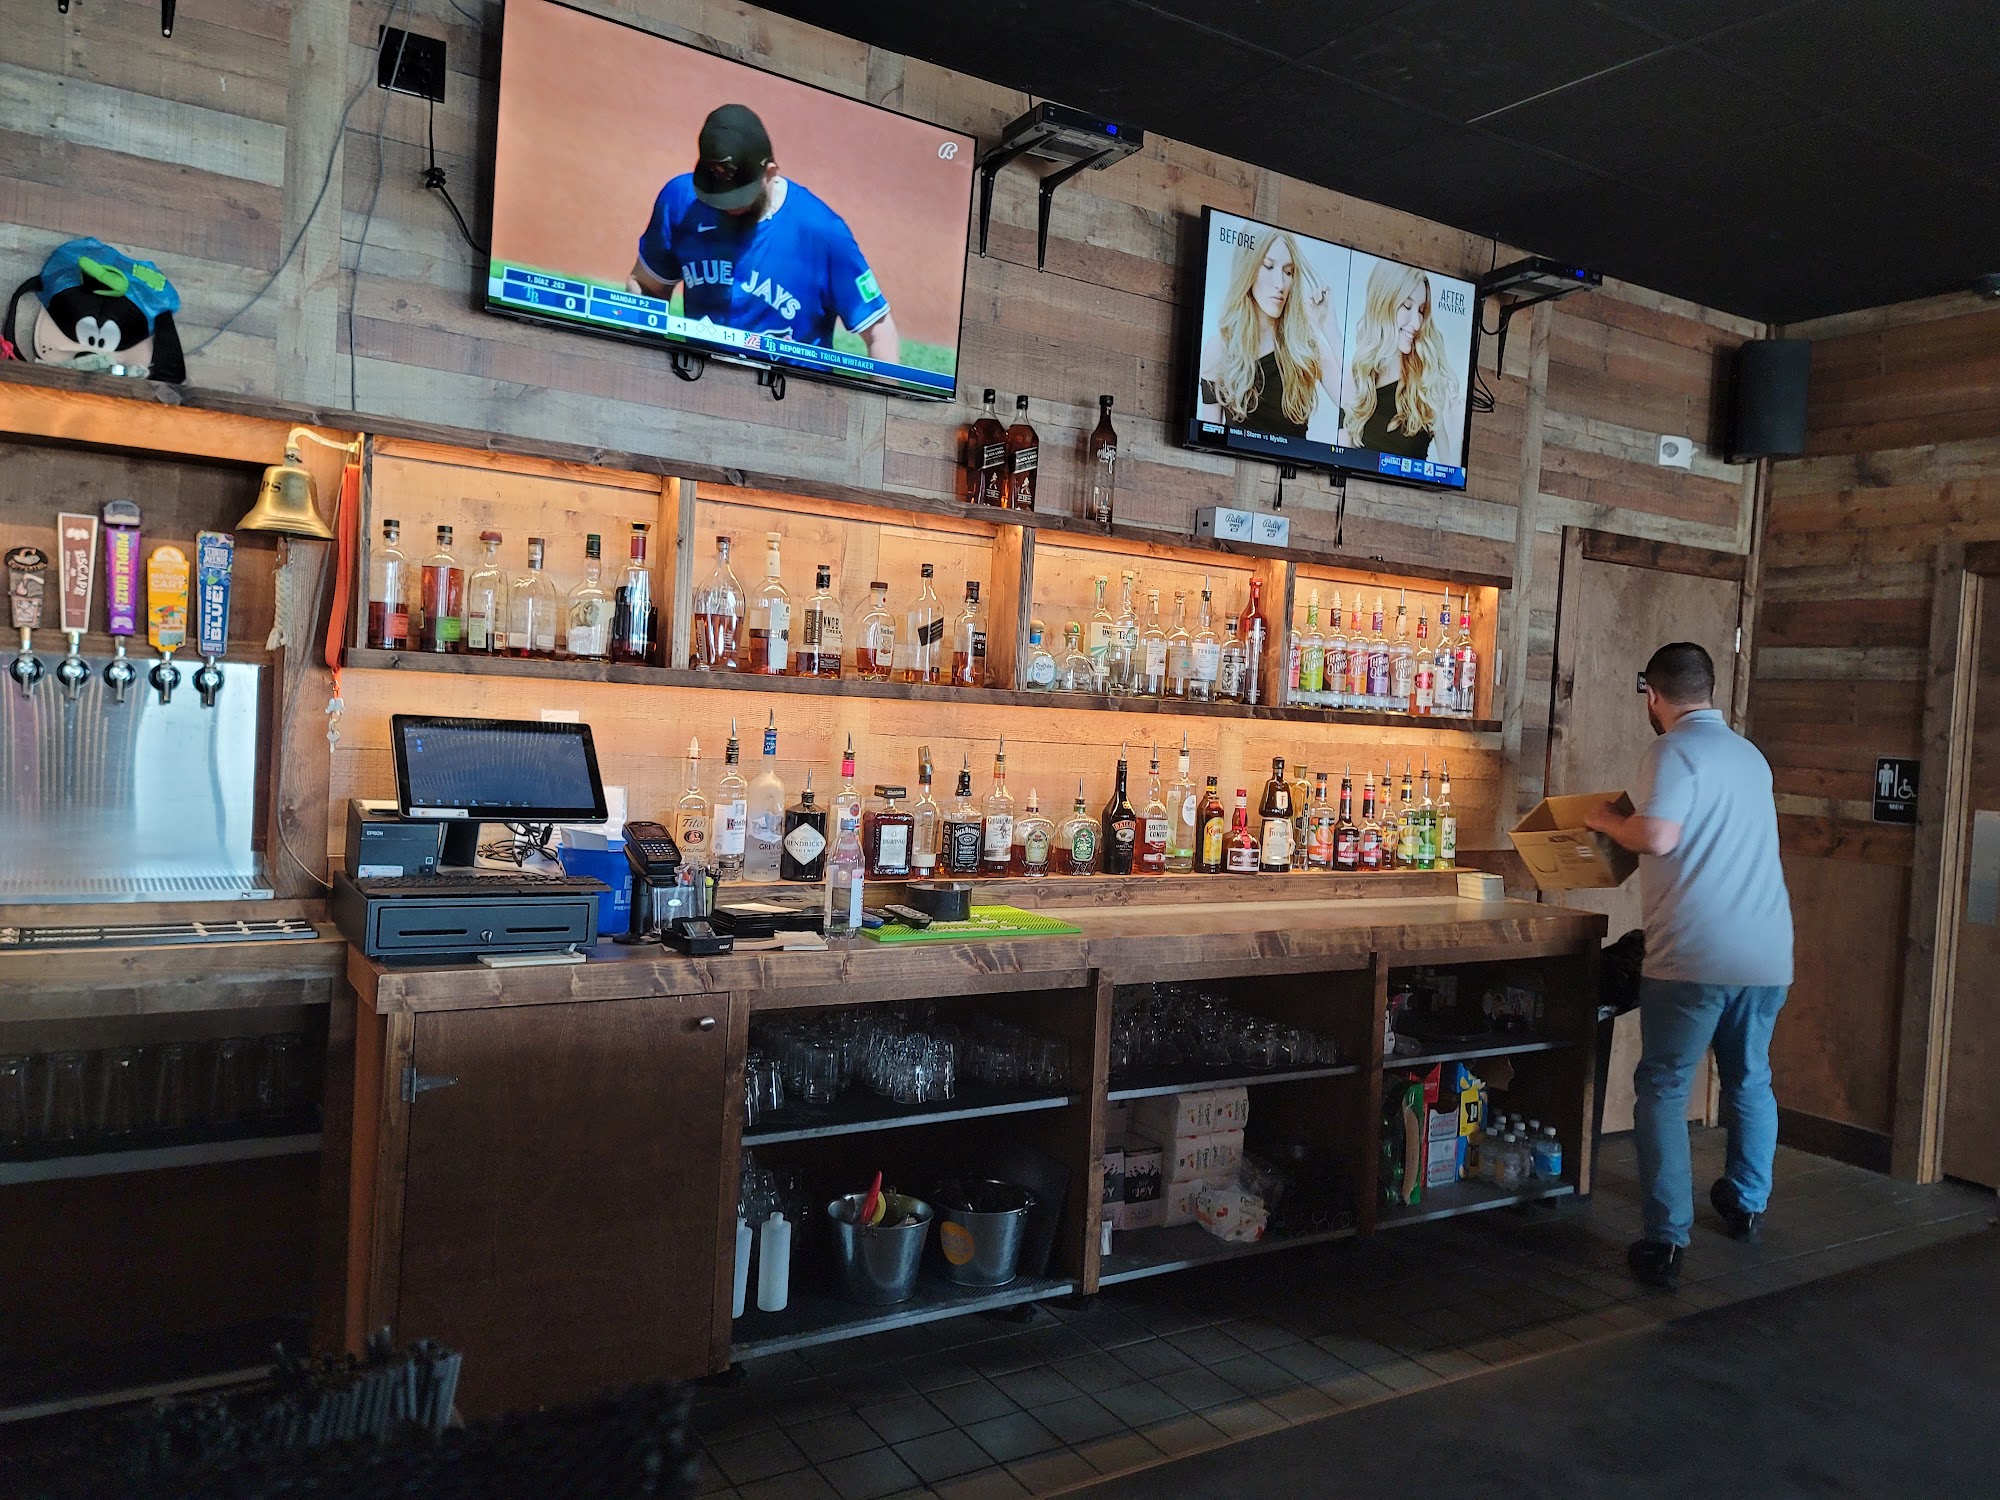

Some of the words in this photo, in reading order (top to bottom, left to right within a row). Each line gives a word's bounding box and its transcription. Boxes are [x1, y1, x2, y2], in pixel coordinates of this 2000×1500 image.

[1219, 226, 1256, 251] BEFORE
[682, 259, 734, 289] BLUE
[741, 270, 801, 320] JAYS
[565, 296, 576, 310] 0
[1440, 288, 1465, 307] AFTER
[1438, 300, 1466, 316] PANTENE
[647, 313, 658, 327] 0
[723, 330, 736, 342] 1-1
[779, 343, 818, 359] REPORTING:
[820, 352, 841, 363] TRICIA
[842, 356, 875, 371] WHITAKER
[1202, 422, 1225, 435] ESPN
[1246, 430, 1262, 440] Storm
[115, 533, 130, 577] PURPLE
[72, 549, 89, 597] ESCAPE
[115, 576, 129, 606] HAZE
[150, 578, 186, 590] CART
[210, 584, 225, 641] BLUE!
[823, 616, 839, 630] KNOB
[1888, 803, 1905, 811] MEN
[682, 818, 707, 828] Tito's
[955, 827, 966, 838] JACK
[758, 843, 777, 851] GREY
[786, 838, 823, 848] HENDRICK'S
